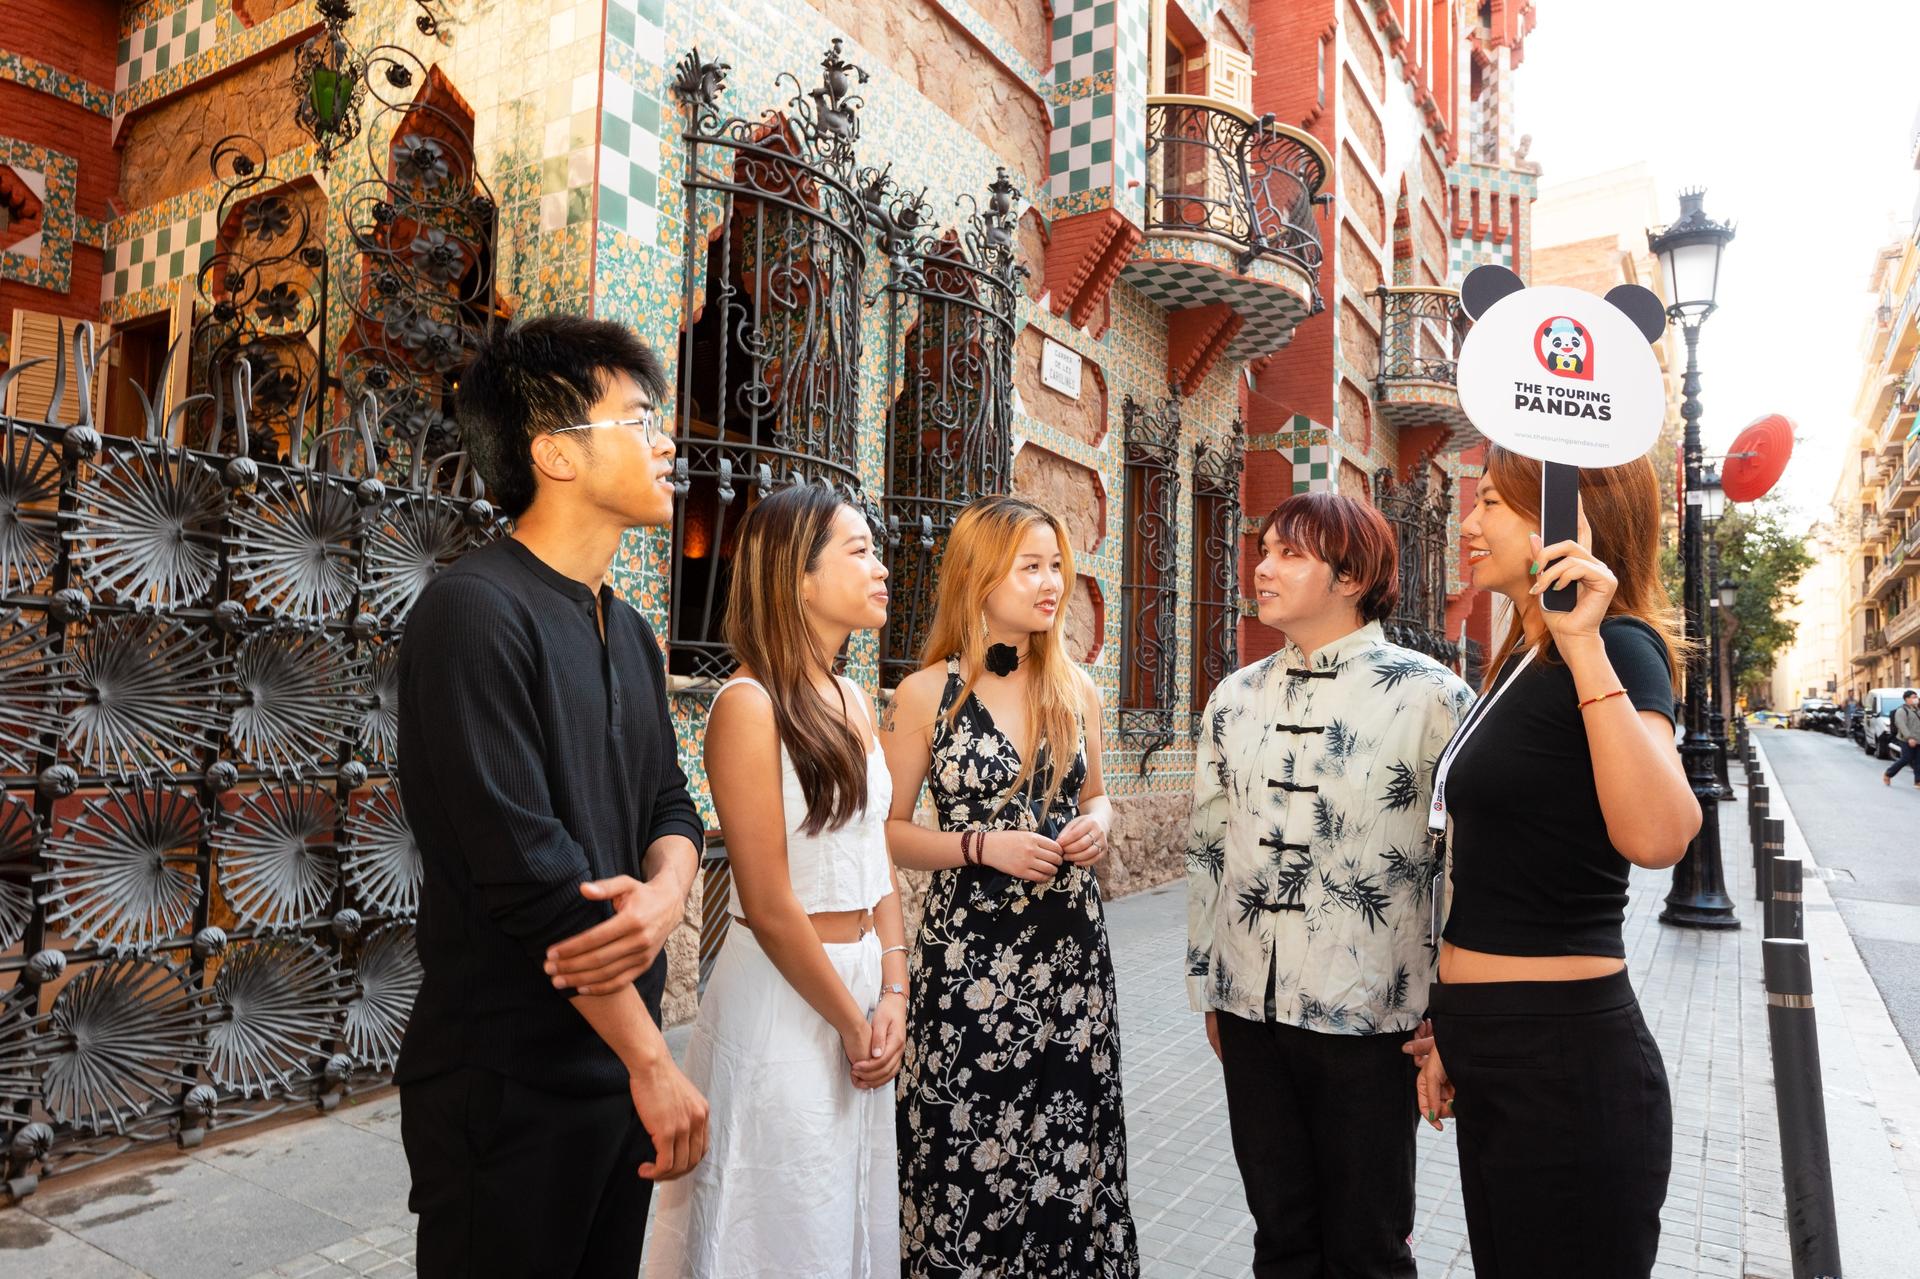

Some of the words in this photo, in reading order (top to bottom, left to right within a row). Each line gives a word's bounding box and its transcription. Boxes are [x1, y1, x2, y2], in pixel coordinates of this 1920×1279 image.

[1514, 381, 1542, 395] THE
[1546, 385, 1610, 403] TOURING
[1515, 394, 1612, 421] PANDAS
[1514, 432, 1610, 449] www.thetouringpandas.com
